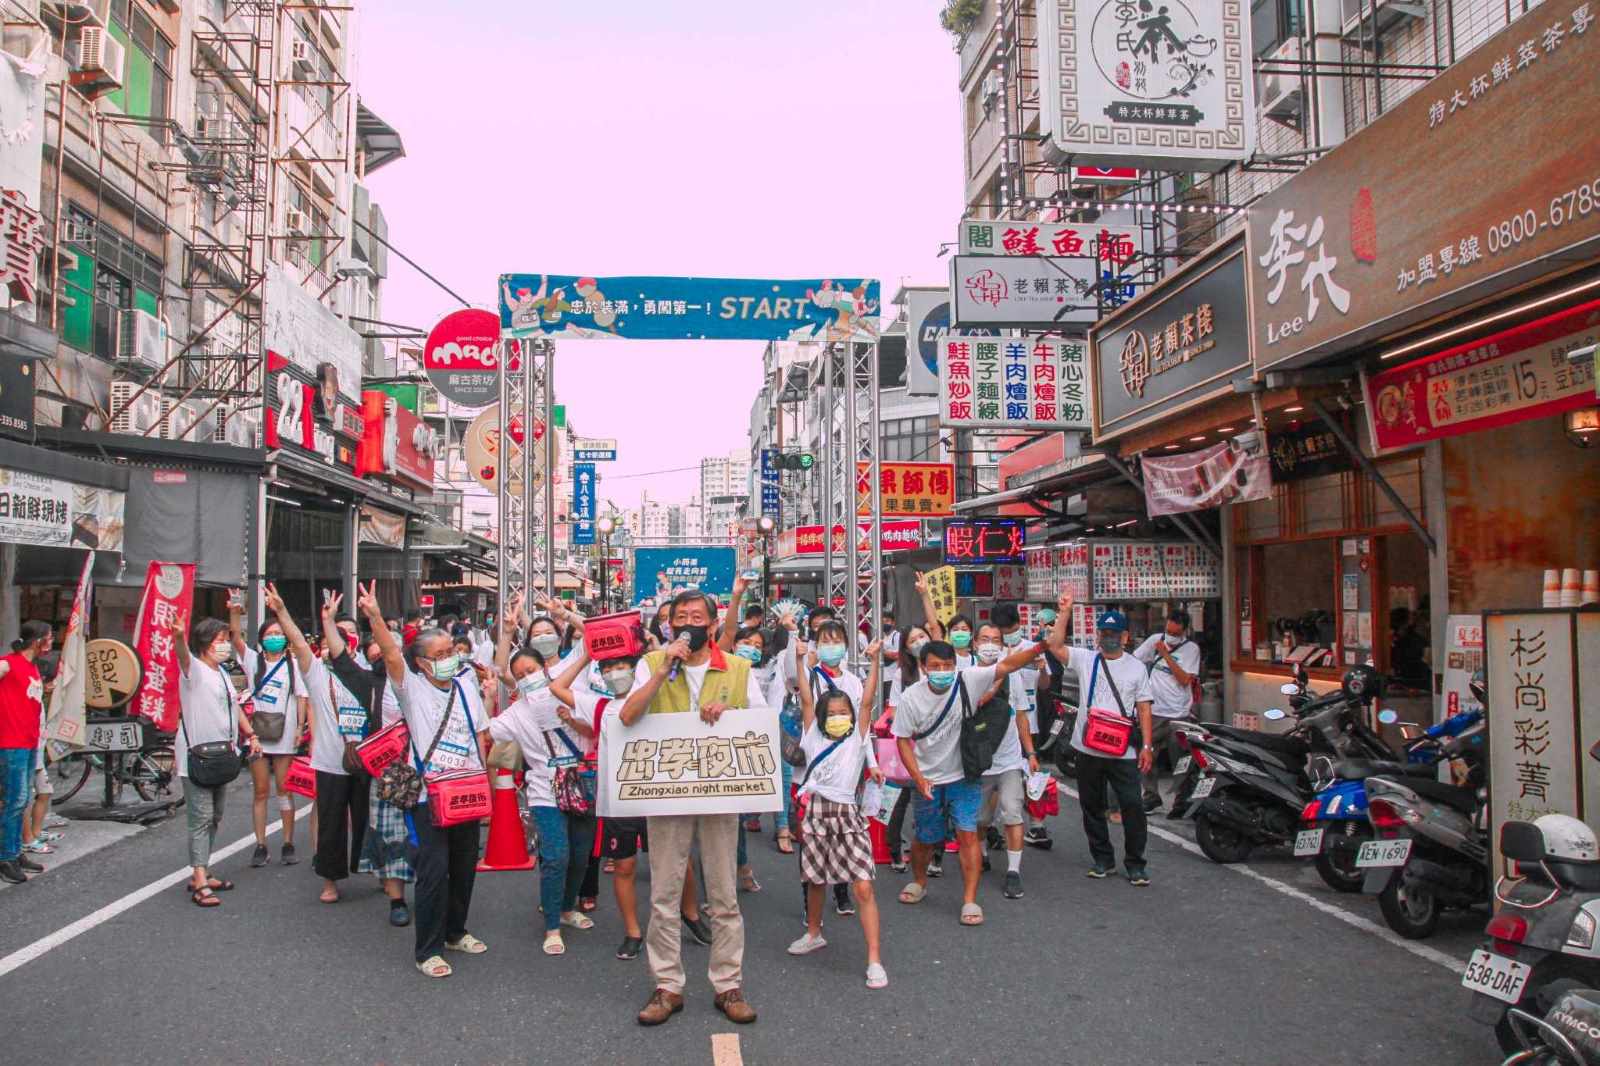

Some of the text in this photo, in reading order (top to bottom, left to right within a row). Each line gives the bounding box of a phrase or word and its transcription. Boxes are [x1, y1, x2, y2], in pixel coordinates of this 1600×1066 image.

[1397, 235, 1482, 292] 加盟專線
[719, 296, 810, 320] START
[1267, 315, 1303, 345] Lee
[947, 342, 972, 420] 鮭魚炒飯
[976, 342, 1000, 420] 腰子麵線
[1005, 343, 1029, 420] 羊肉燴飯
[1033, 343, 1057, 421] 牛肉燴飯
[1061, 344, 1085, 421] 豬心冬粉
[99, 648, 119, 684] Say
[616, 731, 776, 781] 忠孝夜市
[628, 782, 765, 797] Zhongxiao night market
[1466, 962, 1523, 996] 538-DAF
